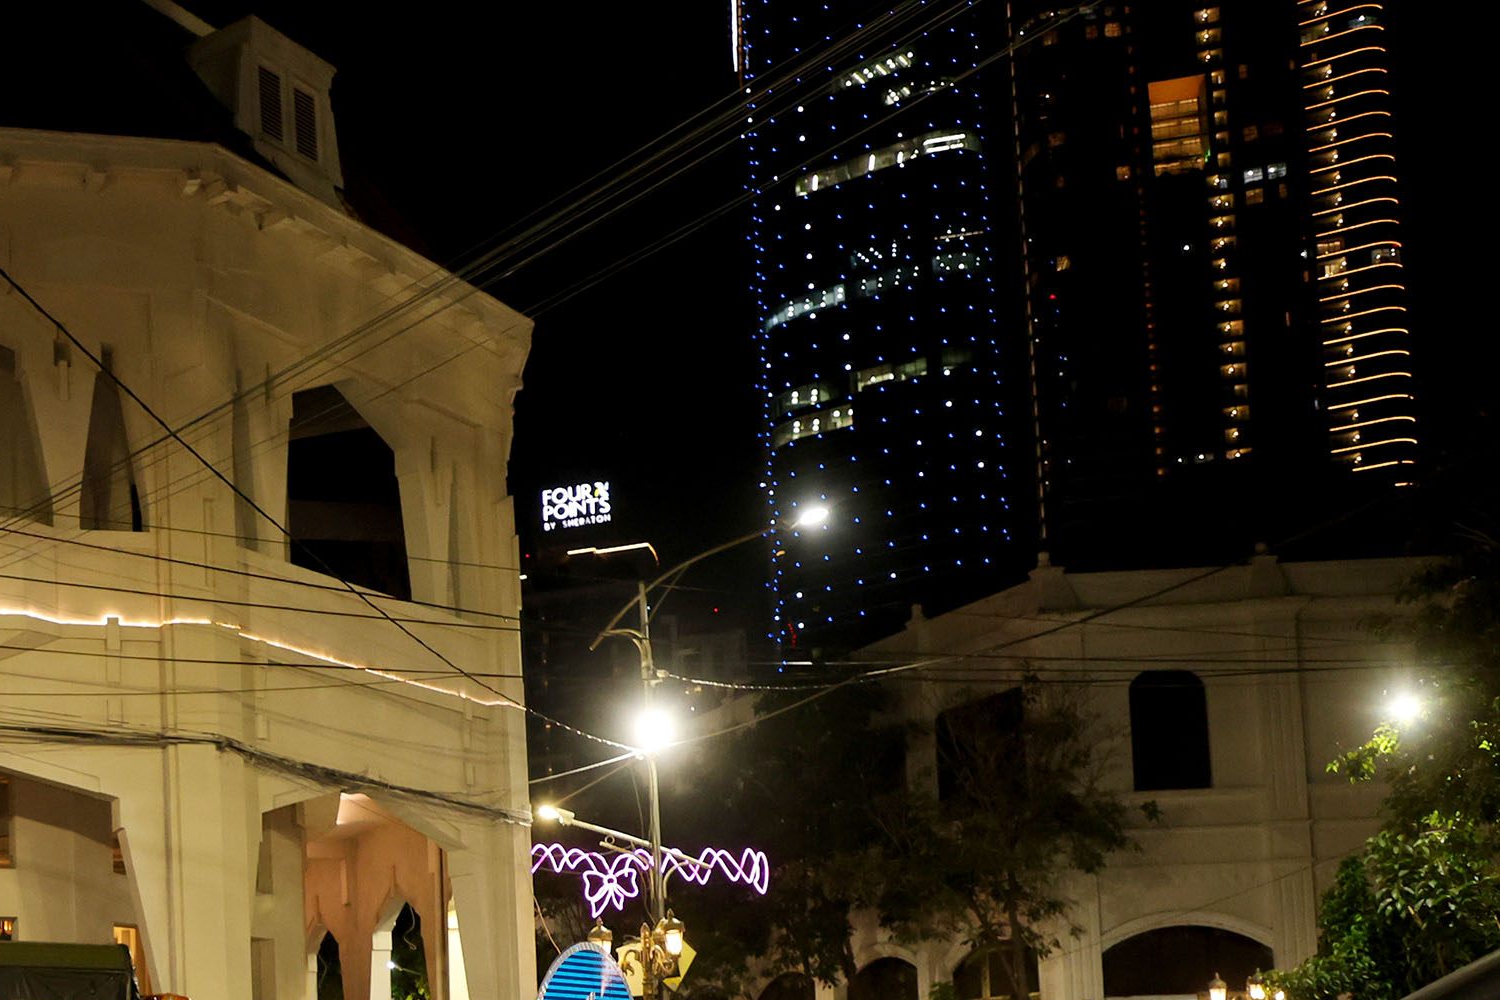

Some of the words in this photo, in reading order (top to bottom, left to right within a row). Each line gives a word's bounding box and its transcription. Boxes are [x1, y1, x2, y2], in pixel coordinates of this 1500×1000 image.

[542, 483, 592, 506] FOUR
[542, 498, 611, 521] POINTS
[543, 521, 557, 532] BY
[562, 513, 612, 529] SHERATON
